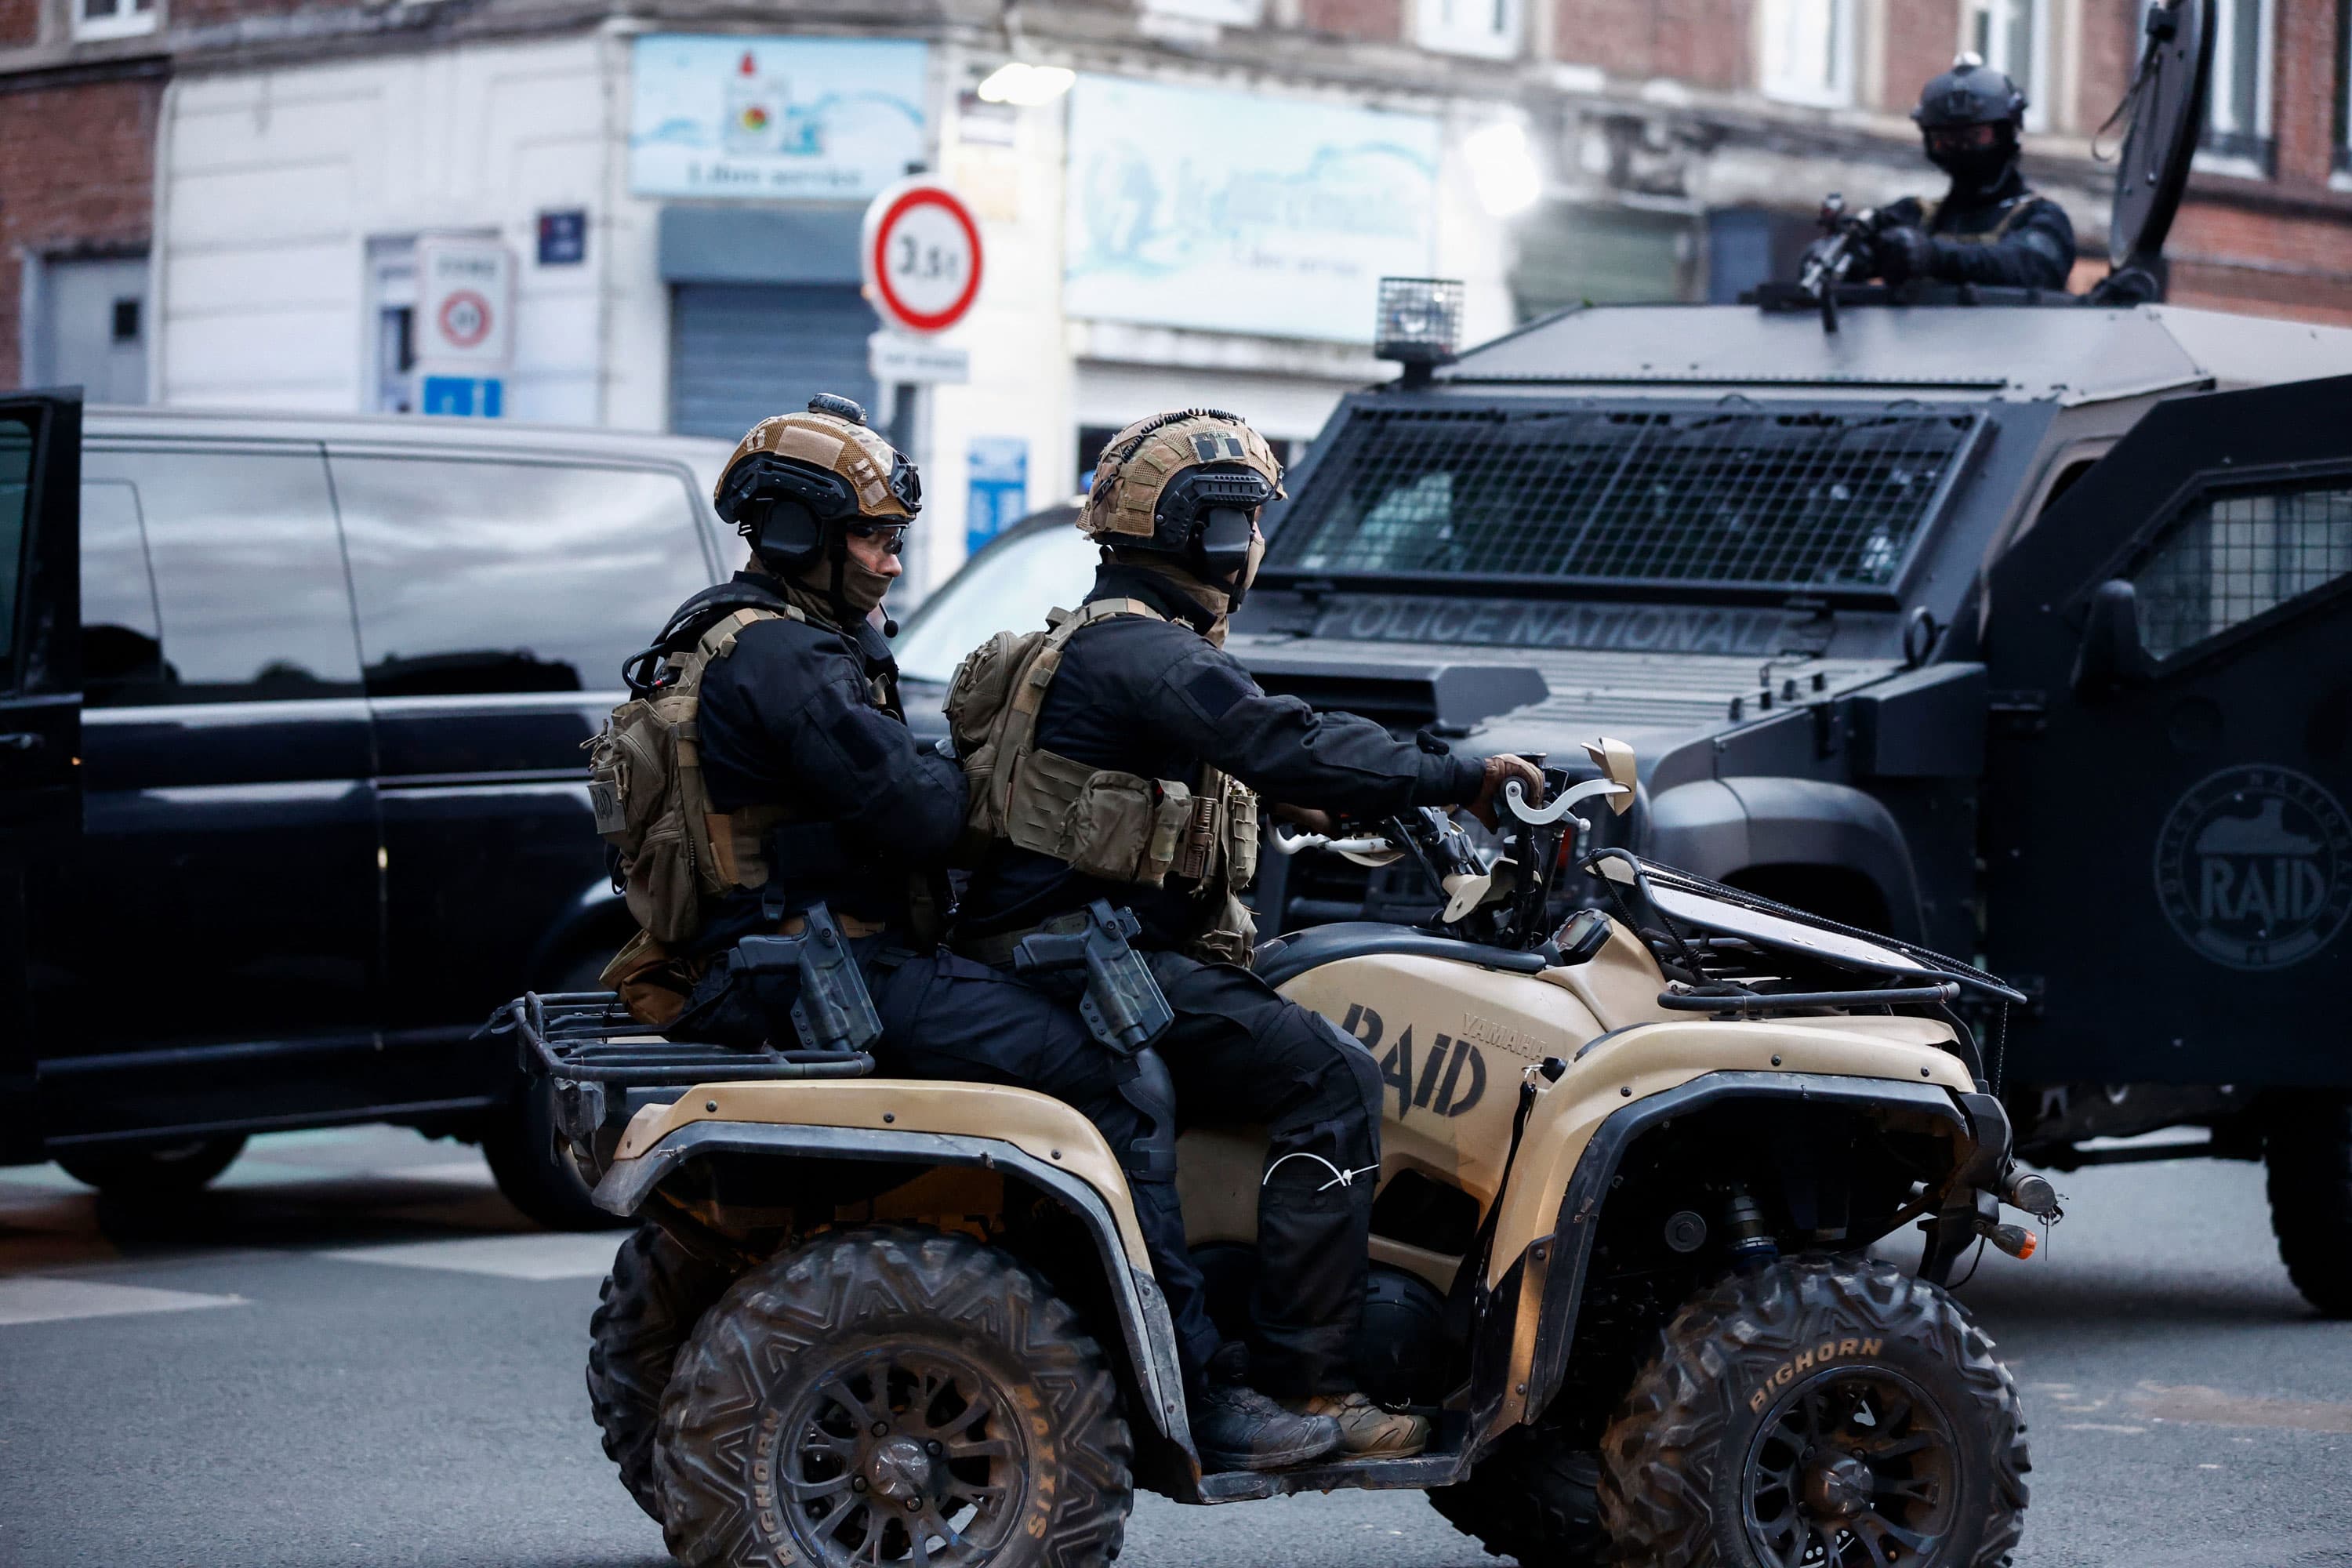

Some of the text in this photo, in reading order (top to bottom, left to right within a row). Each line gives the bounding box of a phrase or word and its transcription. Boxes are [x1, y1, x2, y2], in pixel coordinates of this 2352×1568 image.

[1315, 599, 1505, 641] POLICE
[2200, 857, 2326, 931] RAID
[1463, 1011, 1548, 1062] YAMAHA
[1749, 1337, 1882, 1414] BIGHORN
